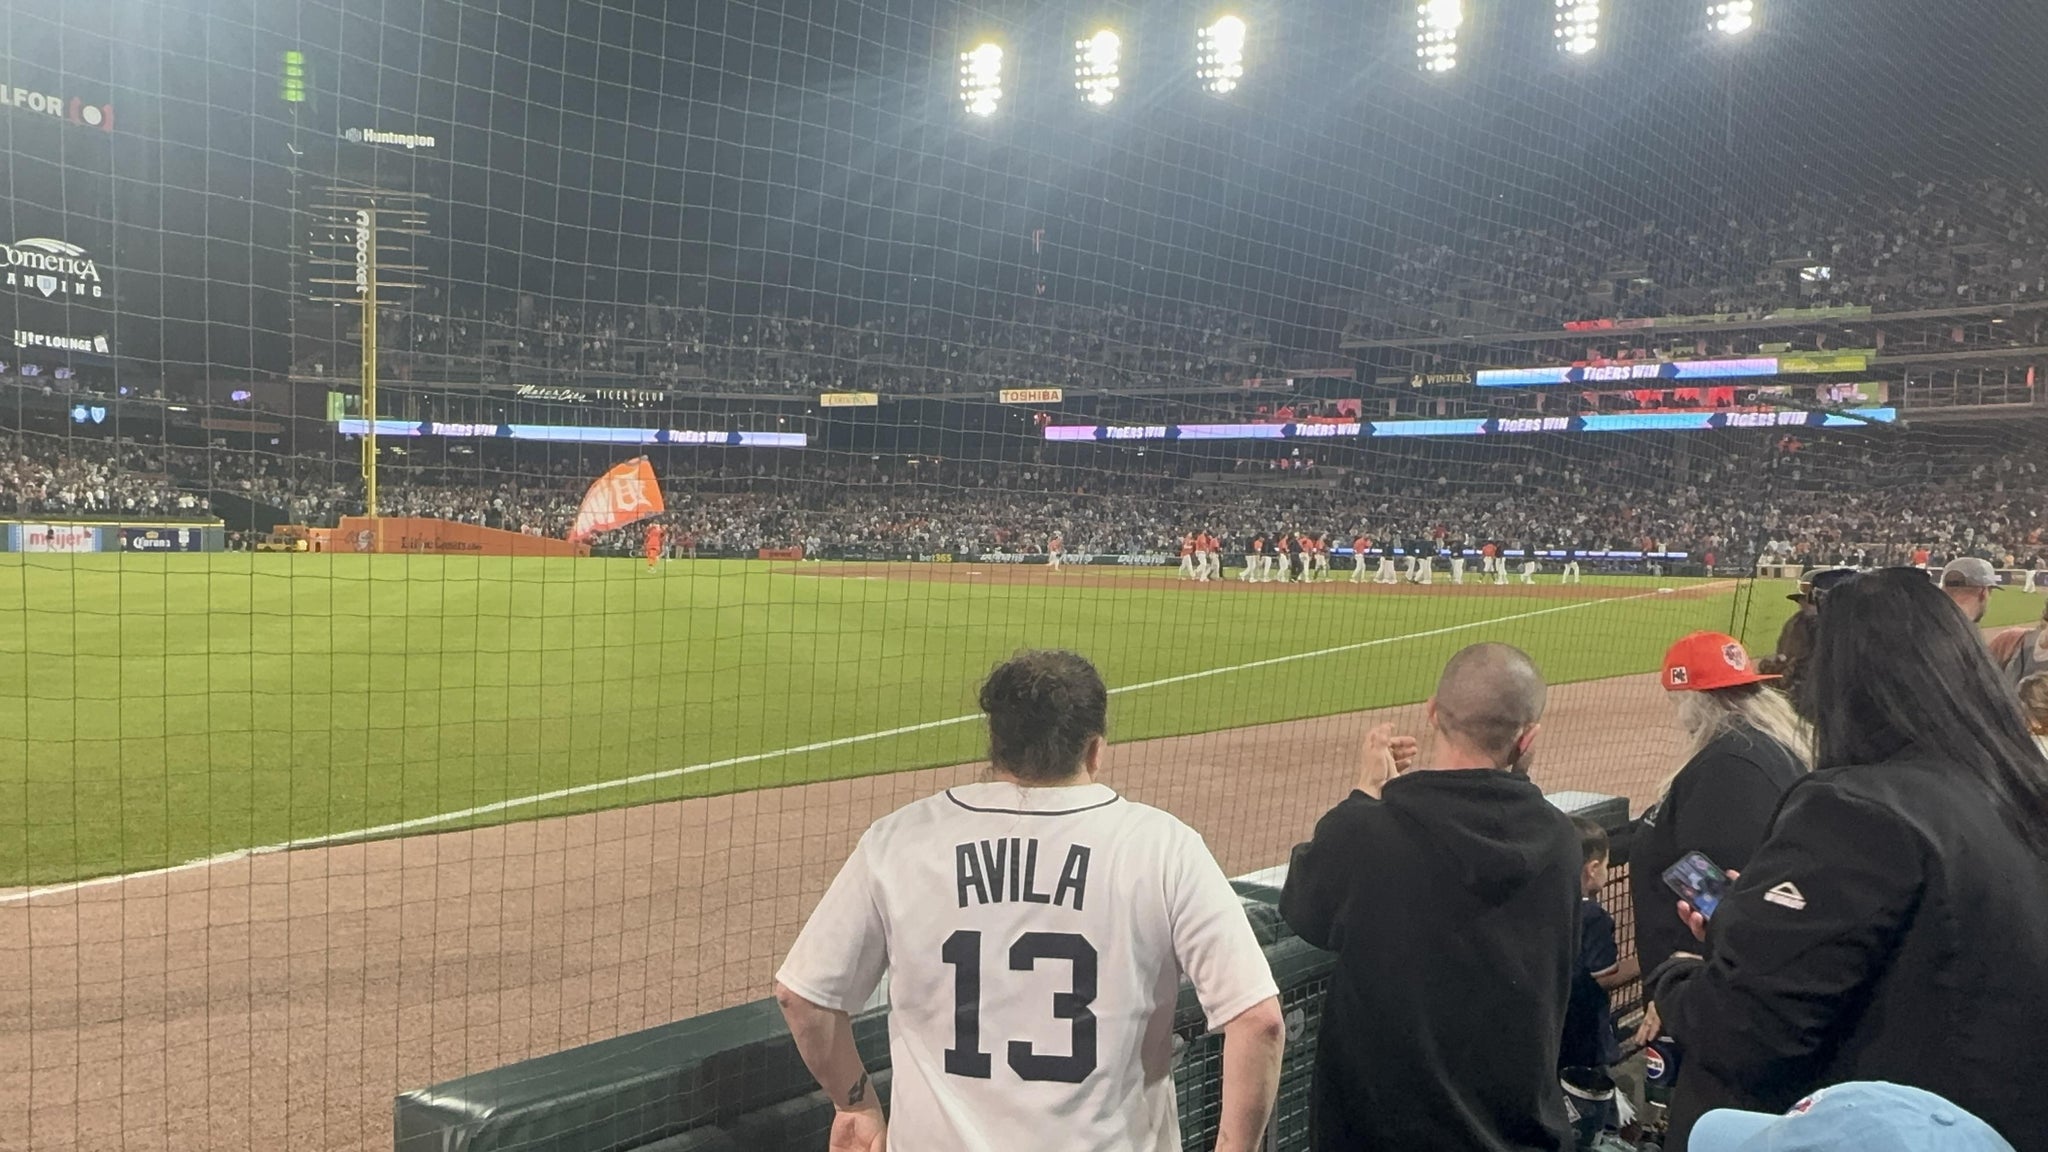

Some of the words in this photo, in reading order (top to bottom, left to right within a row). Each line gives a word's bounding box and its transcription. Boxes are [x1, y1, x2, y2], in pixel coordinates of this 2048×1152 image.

[363, 128, 435, 148] Huntington
[356, 227, 369, 293] Rocket
[45, 335, 92, 351] LOUNGE
[1583, 366, 1630, 381] TIGERS
[1632, 364, 1661, 378] WIN
[513, 384, 559, 397] Motor
[597, 389, 628, 400] TIGER
[639, 391, 664, 401] CLUB
[1002, 391, 1059, 401] TOSHIBA
[1498, 418, 1542, 432] TIGERS
[1543, 417, 1569, 430] WIN
[1725, 413, 1775, 427] TIGERS
[1777, 412, 1808, 425] WIN
[432, 422, 473, 436] TIGERS
[1105, 426, 1144, 439] TIGERS
[1144, 426, 1167, 438] WIN
[1295, 423, 1336, 436] TIGERS
[1337, 423, 1361, 435] WIN
[133, 536, 171, 550] Corona
[956, 837, 1091, 911] AVILA
[942, 930, 1098, 1083] 13
